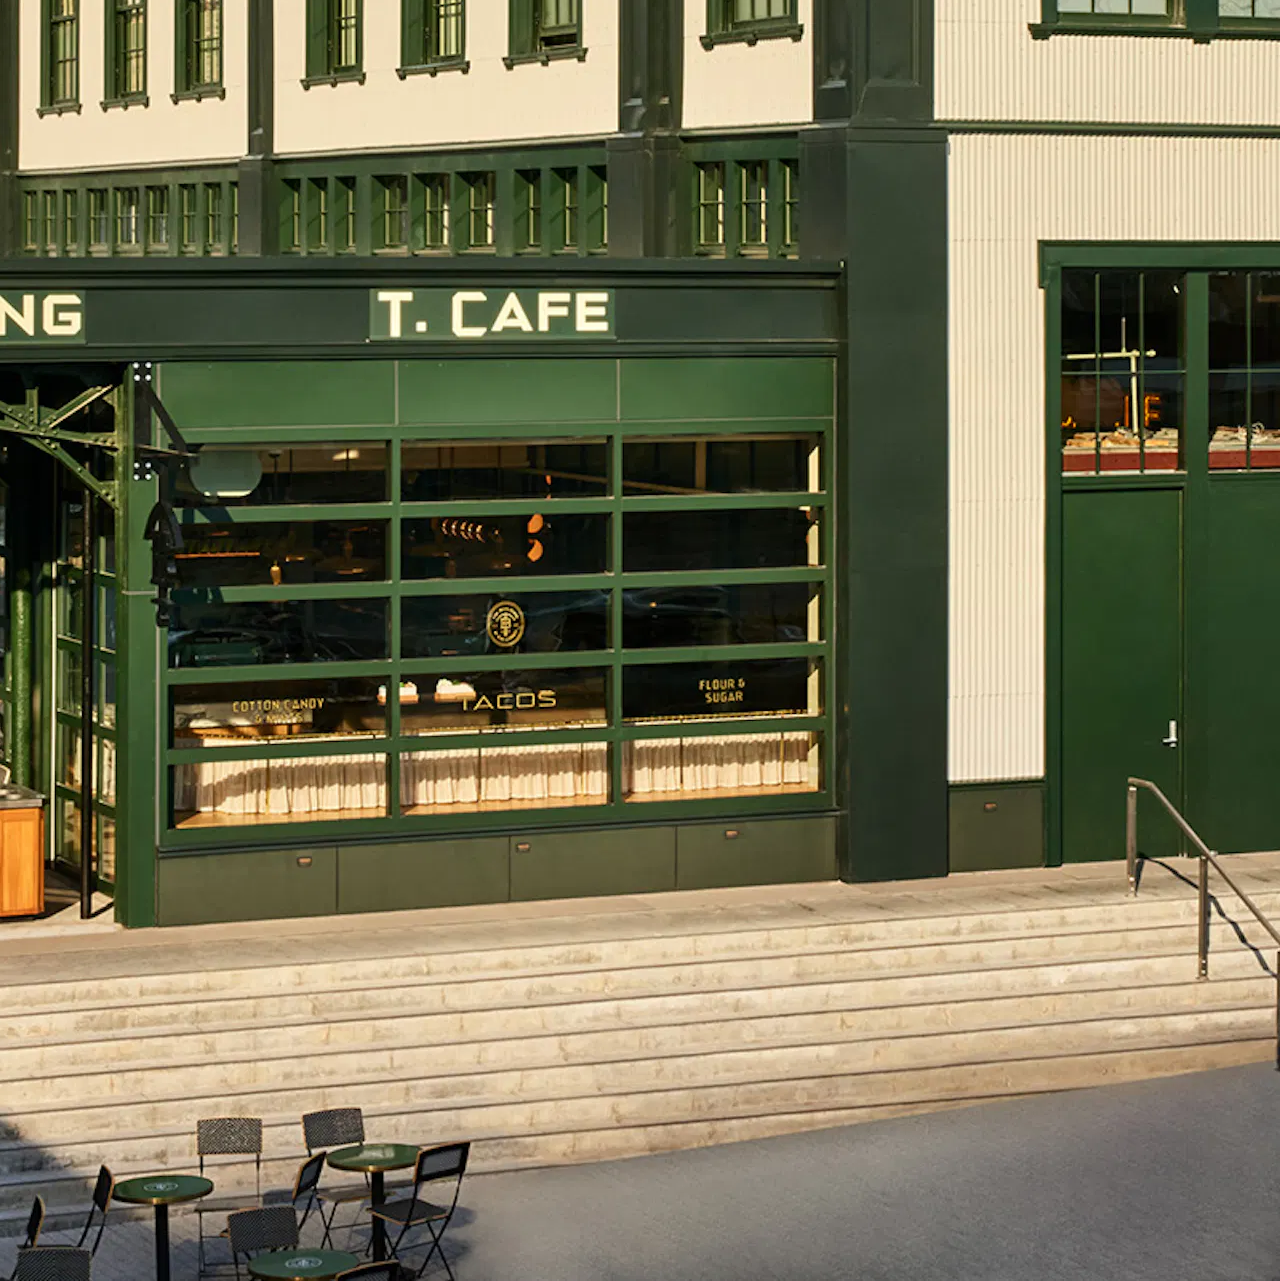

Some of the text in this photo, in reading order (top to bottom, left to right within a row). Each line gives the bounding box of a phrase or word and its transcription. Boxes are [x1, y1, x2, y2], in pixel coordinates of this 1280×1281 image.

[377, 291, 609, 338] T. CAFE
[698, 677, 746, 691] FLOUR &
[232, 697, 325, 713] COTTON CANDY
[460, 688, 558, 712] TACOS
[704, 690, 744, 705] SUGAR
